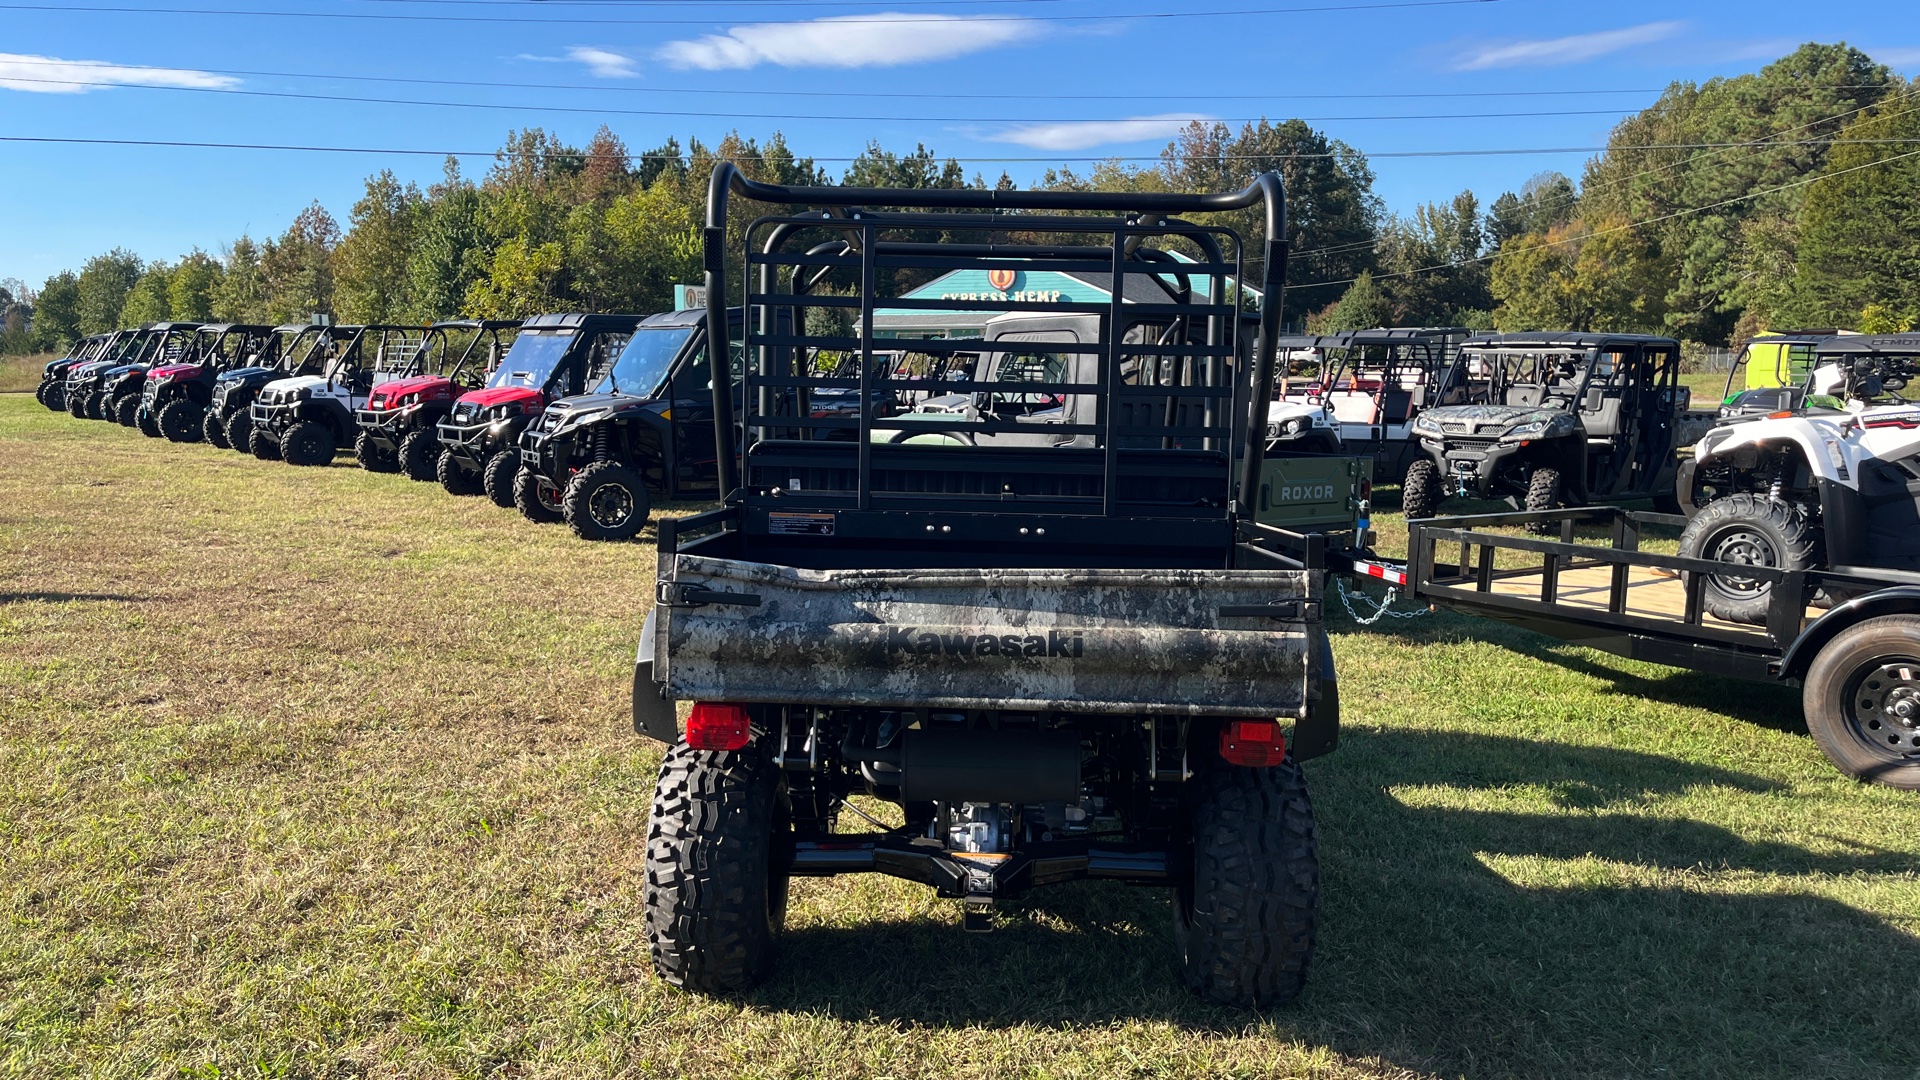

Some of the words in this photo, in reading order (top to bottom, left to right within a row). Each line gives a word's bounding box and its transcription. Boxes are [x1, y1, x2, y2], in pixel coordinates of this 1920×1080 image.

[1014, 290, 1061, 302] HEMP
[1281, 485, 1333, 501] ROXOR
[887, 626, 1083, 658] Kawasaki
